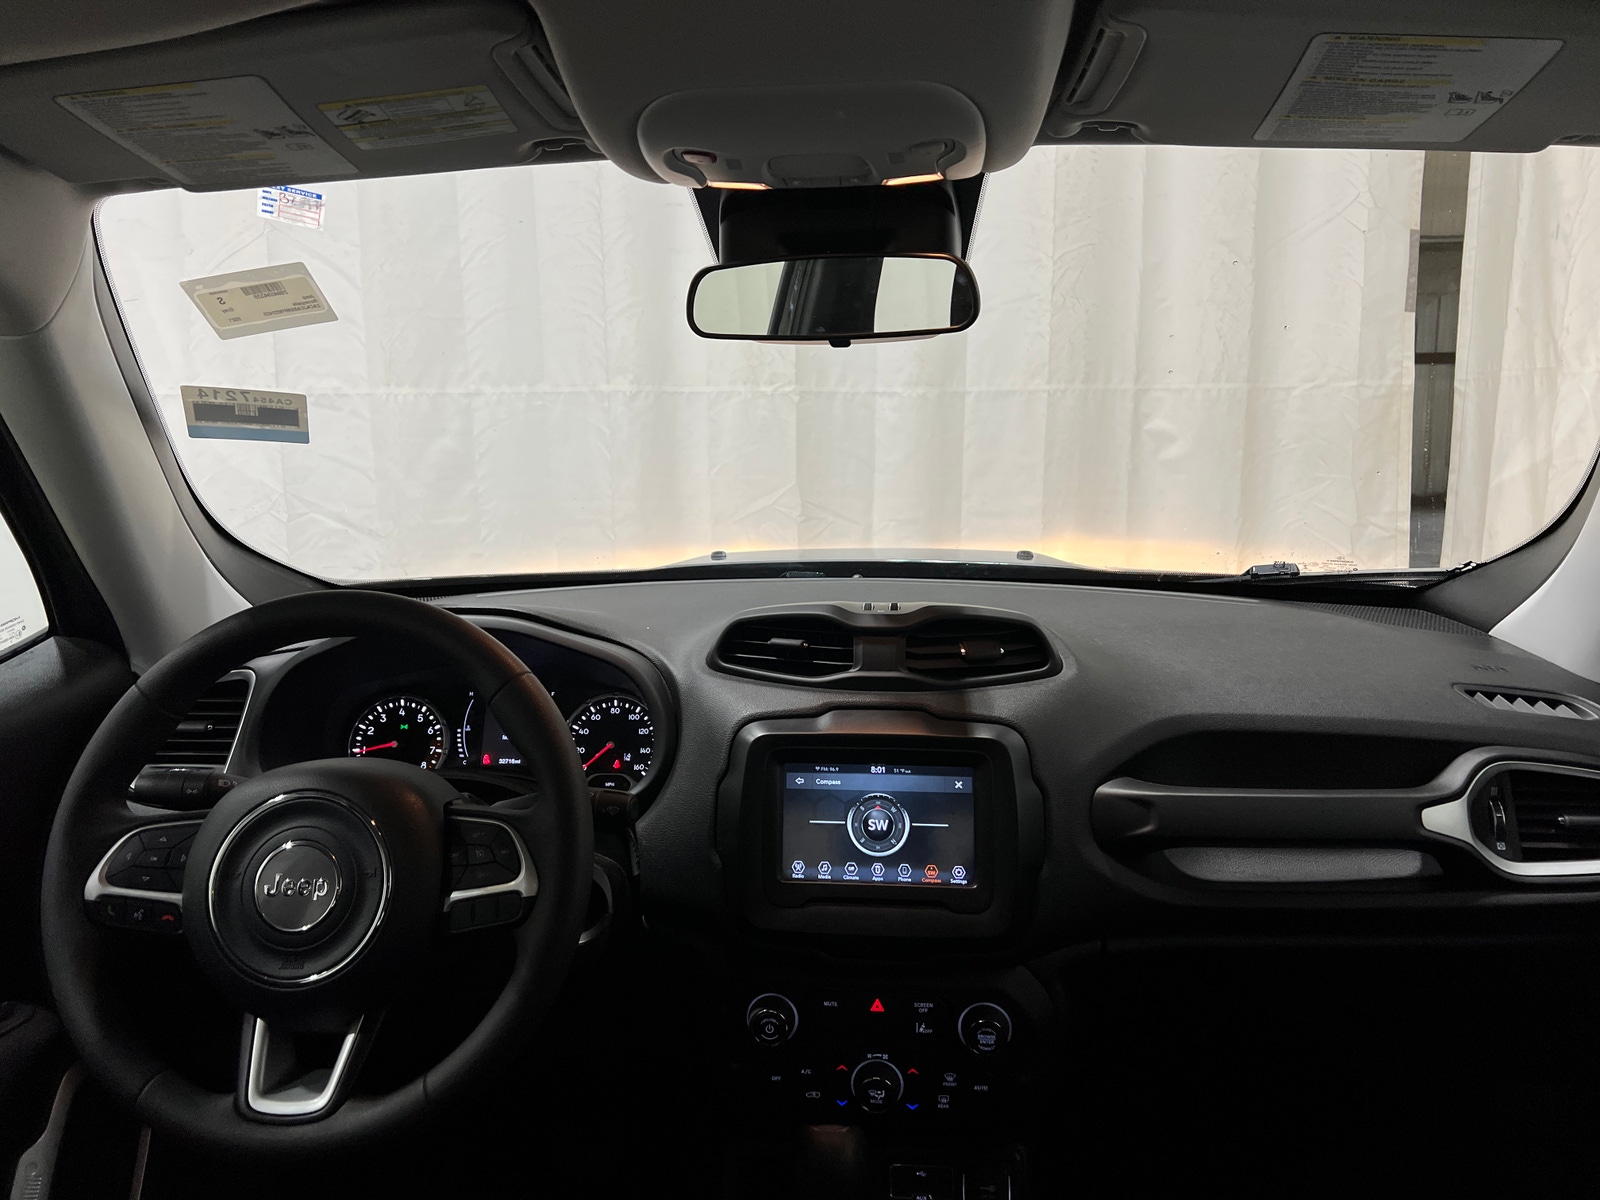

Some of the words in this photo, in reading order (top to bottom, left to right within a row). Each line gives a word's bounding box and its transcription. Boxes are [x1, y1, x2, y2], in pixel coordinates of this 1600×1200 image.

[287, 187, 317, 198] SERVICE
[398, 708, 406, 717] 4
[590, 713, 601, 721] 60
[628, 713, 640, 721] 100
[379, 714, 387, 723] 3
[416, 714, 424, 723] 5
[367, 726, 375, 735] 2
[427, 726, 434, 735] 6
[429, 746, 436, 755] 7
[420, 761, 427, 769] 8
[870, 765, 886, 774] 8:01
[815, 778, 841, 786] Compass
[867, 819, 889, 831] SW
[922, 877, 942, 885] Compass
[950, 878, 968, 886] Settings
[263, 873, 329, 901] Jeep
